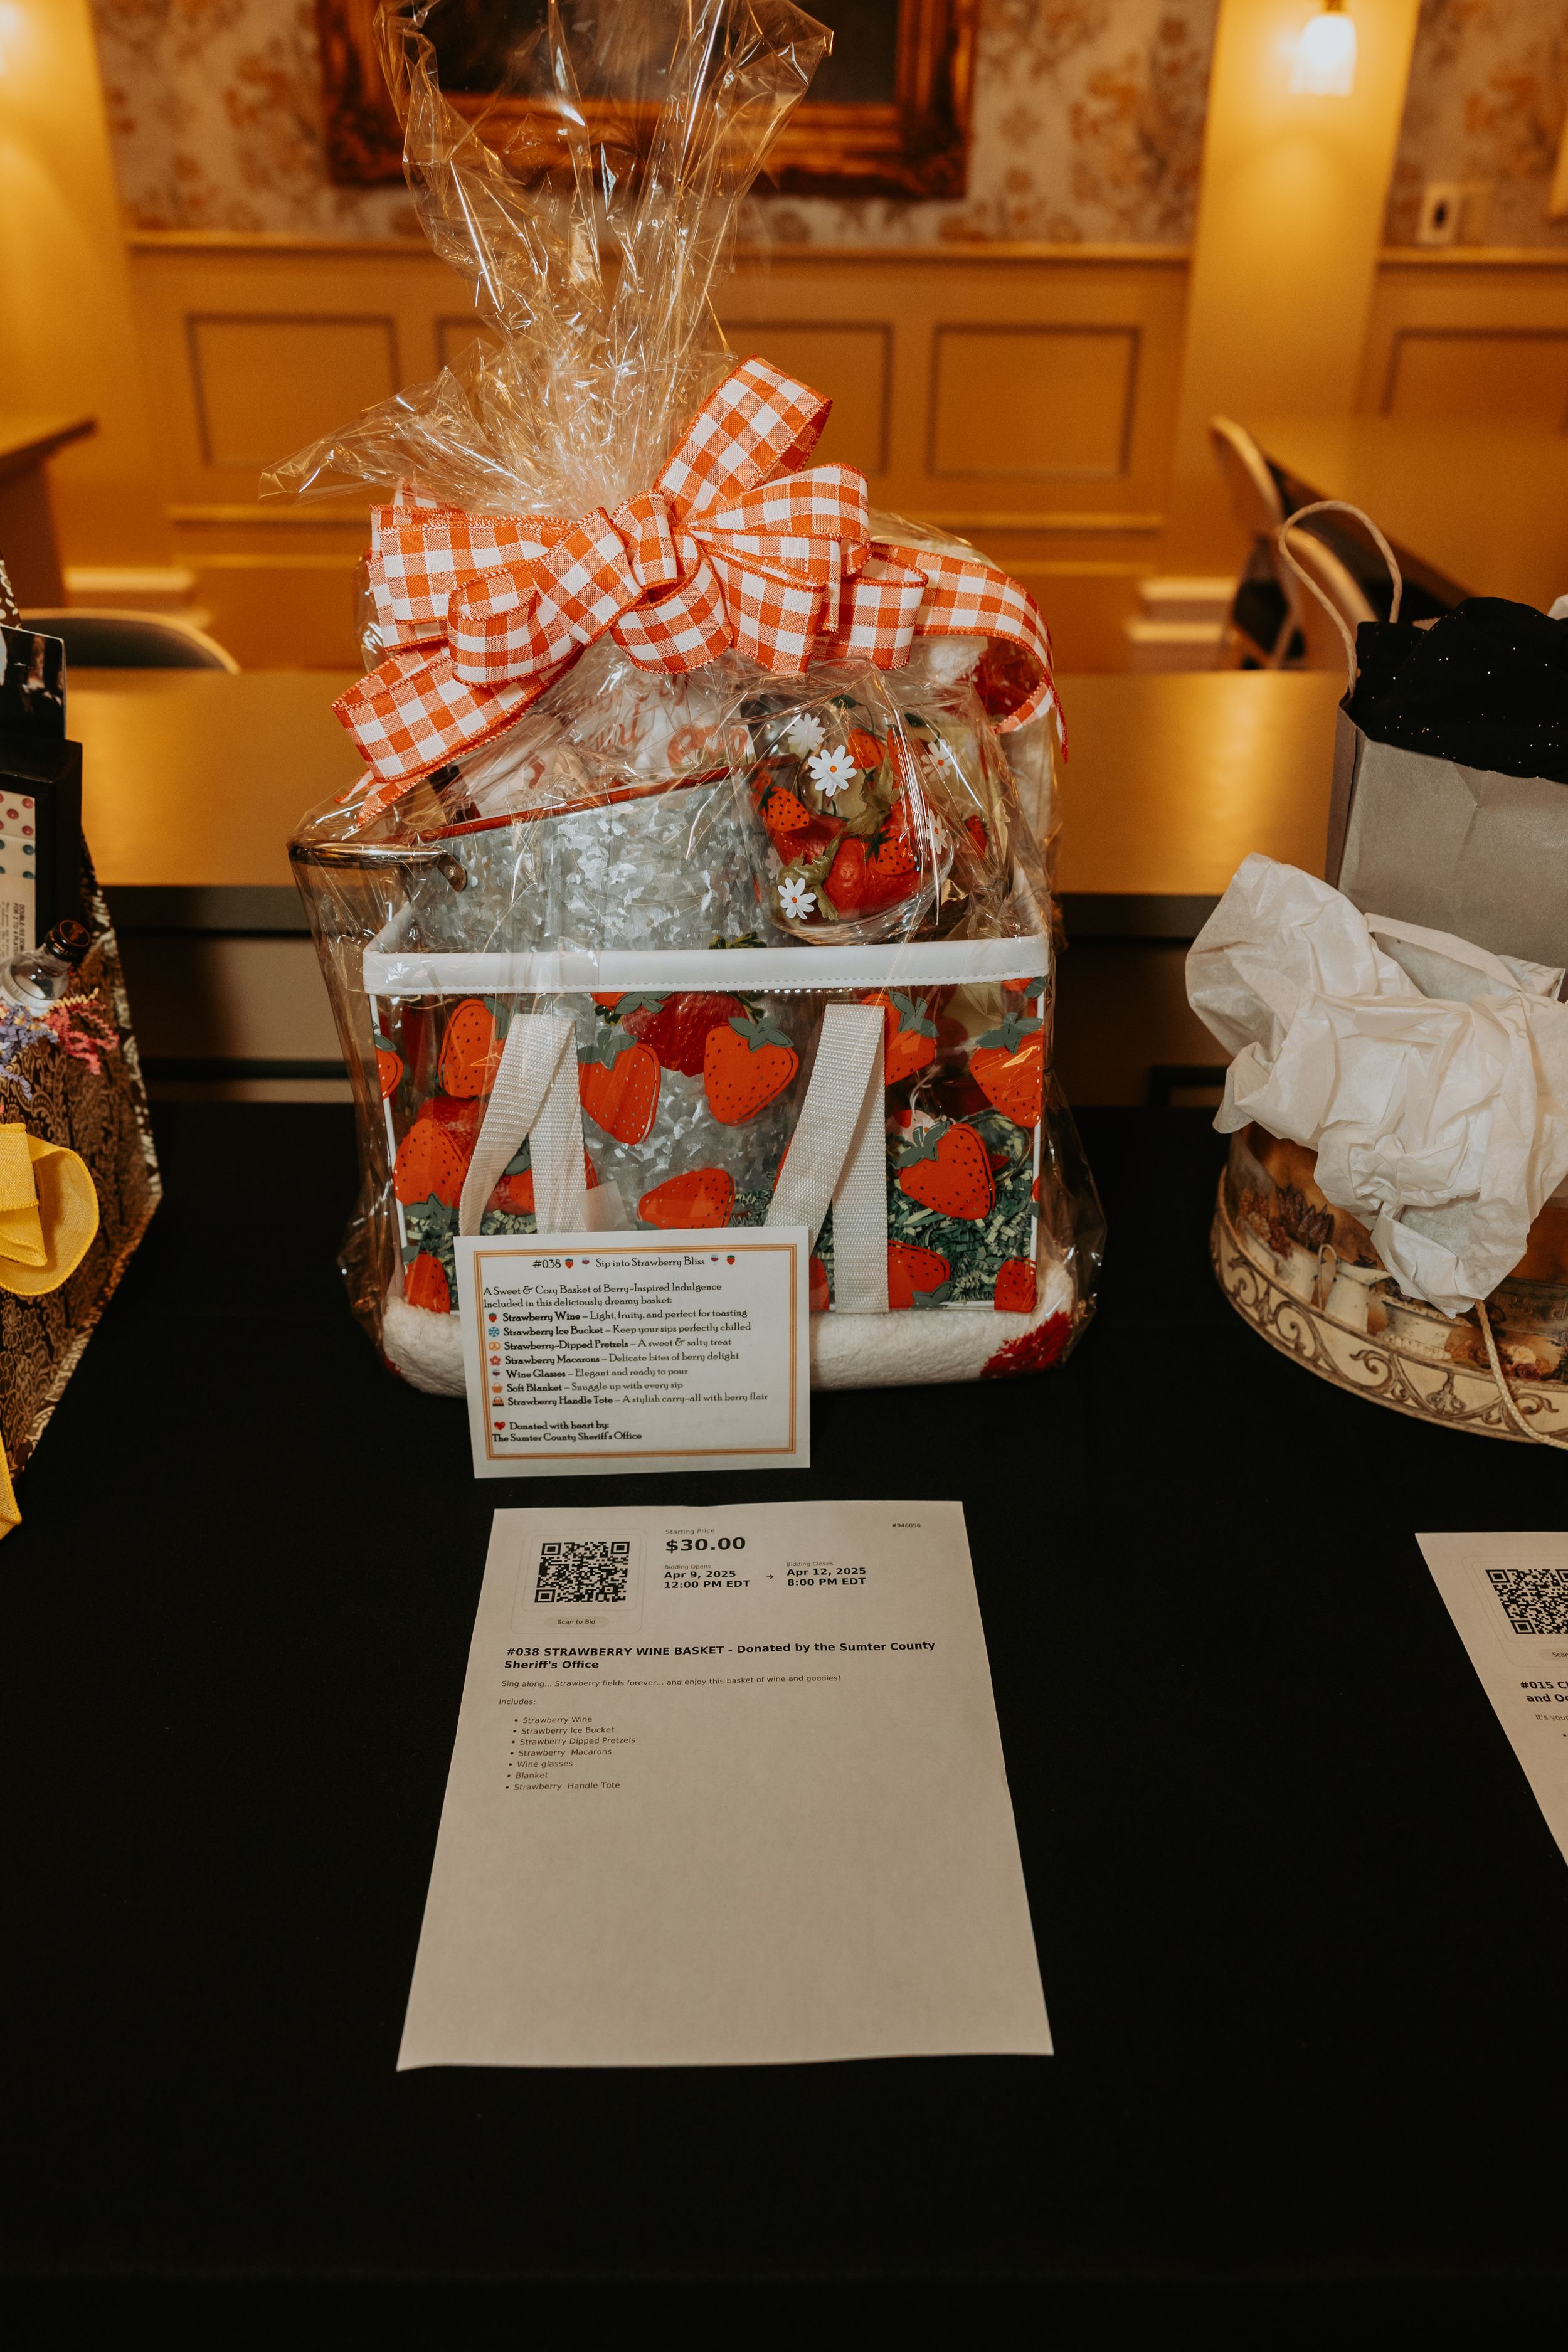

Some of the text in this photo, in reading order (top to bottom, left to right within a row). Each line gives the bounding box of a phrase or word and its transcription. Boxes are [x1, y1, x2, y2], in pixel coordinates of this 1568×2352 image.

[532, 1259, 561, 1268] #038
[596, 1258, 611, 1269] Sip
[632, 1257, 681, 1268] Strawberry
[684, 1256, 705, 1265] Bliss
[484, 1282, 722, 1296] A Sweet & Cozy Basket of Berry-Inspired Indulgence
[484, 1299, 524, 1309] Included
[536, 1298, 552, 1306] this
[554, 1295, 602, 1307] deliciously
[605, 1296, 638, 1306] dreamy
[641, 1295, 672, 1304] basket:
[502, 1312, 553, 1322] Strawberry
[554, 1311, 581, 1320] Wine
[590, 1311, 616, 1321] Light,
[618, 1311, 645, 1320] fruity,
[646, 1310, 663, 1318] and
[665, 1310, 696, 1320] perfect
[699, 1309, 711, 1317] for
[504, 1327, 553, 1337] Strawberry
[555, 1326, 569, 1335] Ice
[570, 1325, 603, 1335] Bucket
[613, 1325, 637, 1335] Keep
[660, 1326, 677, 1334] sips
[679, 1323, 718, 1333] perfectly
[720, 1322, 751, 1331] chilled
[504, 1340, 593, 1351] Strawberry-Dipped
[594, 1339, 628, 1348] Pretzels
[638, 1339, 646, 1347] A
[675, 1338, 685, 1346] &
[687, 1337, 708, 1347] salty
[505, 1351, 738, 1365] Strawberry Macarons Delicate bites of berry delight
[506, 1370, 532, 1379] Wine
[532, 1369, 566, 1377] Glasses
[575, 1368, 609, 1378] Elegant
[611, 1367, 628, 1375] and
[630, 1367, 655, 1377] ready
[507, 1384, 524, 1392] Soft
[526, 1383, 562, 1392] Blanket
[571, 1382, 608, 1392] Snuggle
[507, 1397, 557, 1406] Strawberry
[559, 1395, 592, 1404] Handle
[594, 1396, 613, 1404] Tote
[622, 1395, 630, 1403] A
[632, 1394, 660, 1404] stylish
[662, 1394, 701, 1403] carry-all
[703, 1393, 723, 1401] with
[724, 1392, 747, 1402] berry
[509, 1420, 609, 1430] Donated with heart by:
[492, 1431, 642, 1443] The Sumter County Sheriff's Office
[666, 1537, 746, 1554] $30.00
[664, 1572, 686, 1580] Apr
[787, 1569, 809, 1577] Apr
[813, 1568, 831, 1576] 12,
[507, 1648, 539, 1656] #038
[544, 1648, 632, 1656] STRAWBERRY
[636, 1647, 669, 1656] WINE
[675, 1646, 724, 1655] BASKET
[738, 1643, 790, 1653] Donated
[795, 1643, 810, 1653] by
[814, 1643, 835, 1651] the
[891, 1641, 935, 1651] County
[562, 1660, 599, 1668] Office
[1520, 1681, 1554, 1689] #015
[1526, 1693, 1552, 1702] and
[569, 1737, 599, 1745] Dipped
[519, 1749, 566, 1757] Strawberry
[541, 1761, 573, 1769] glasses
